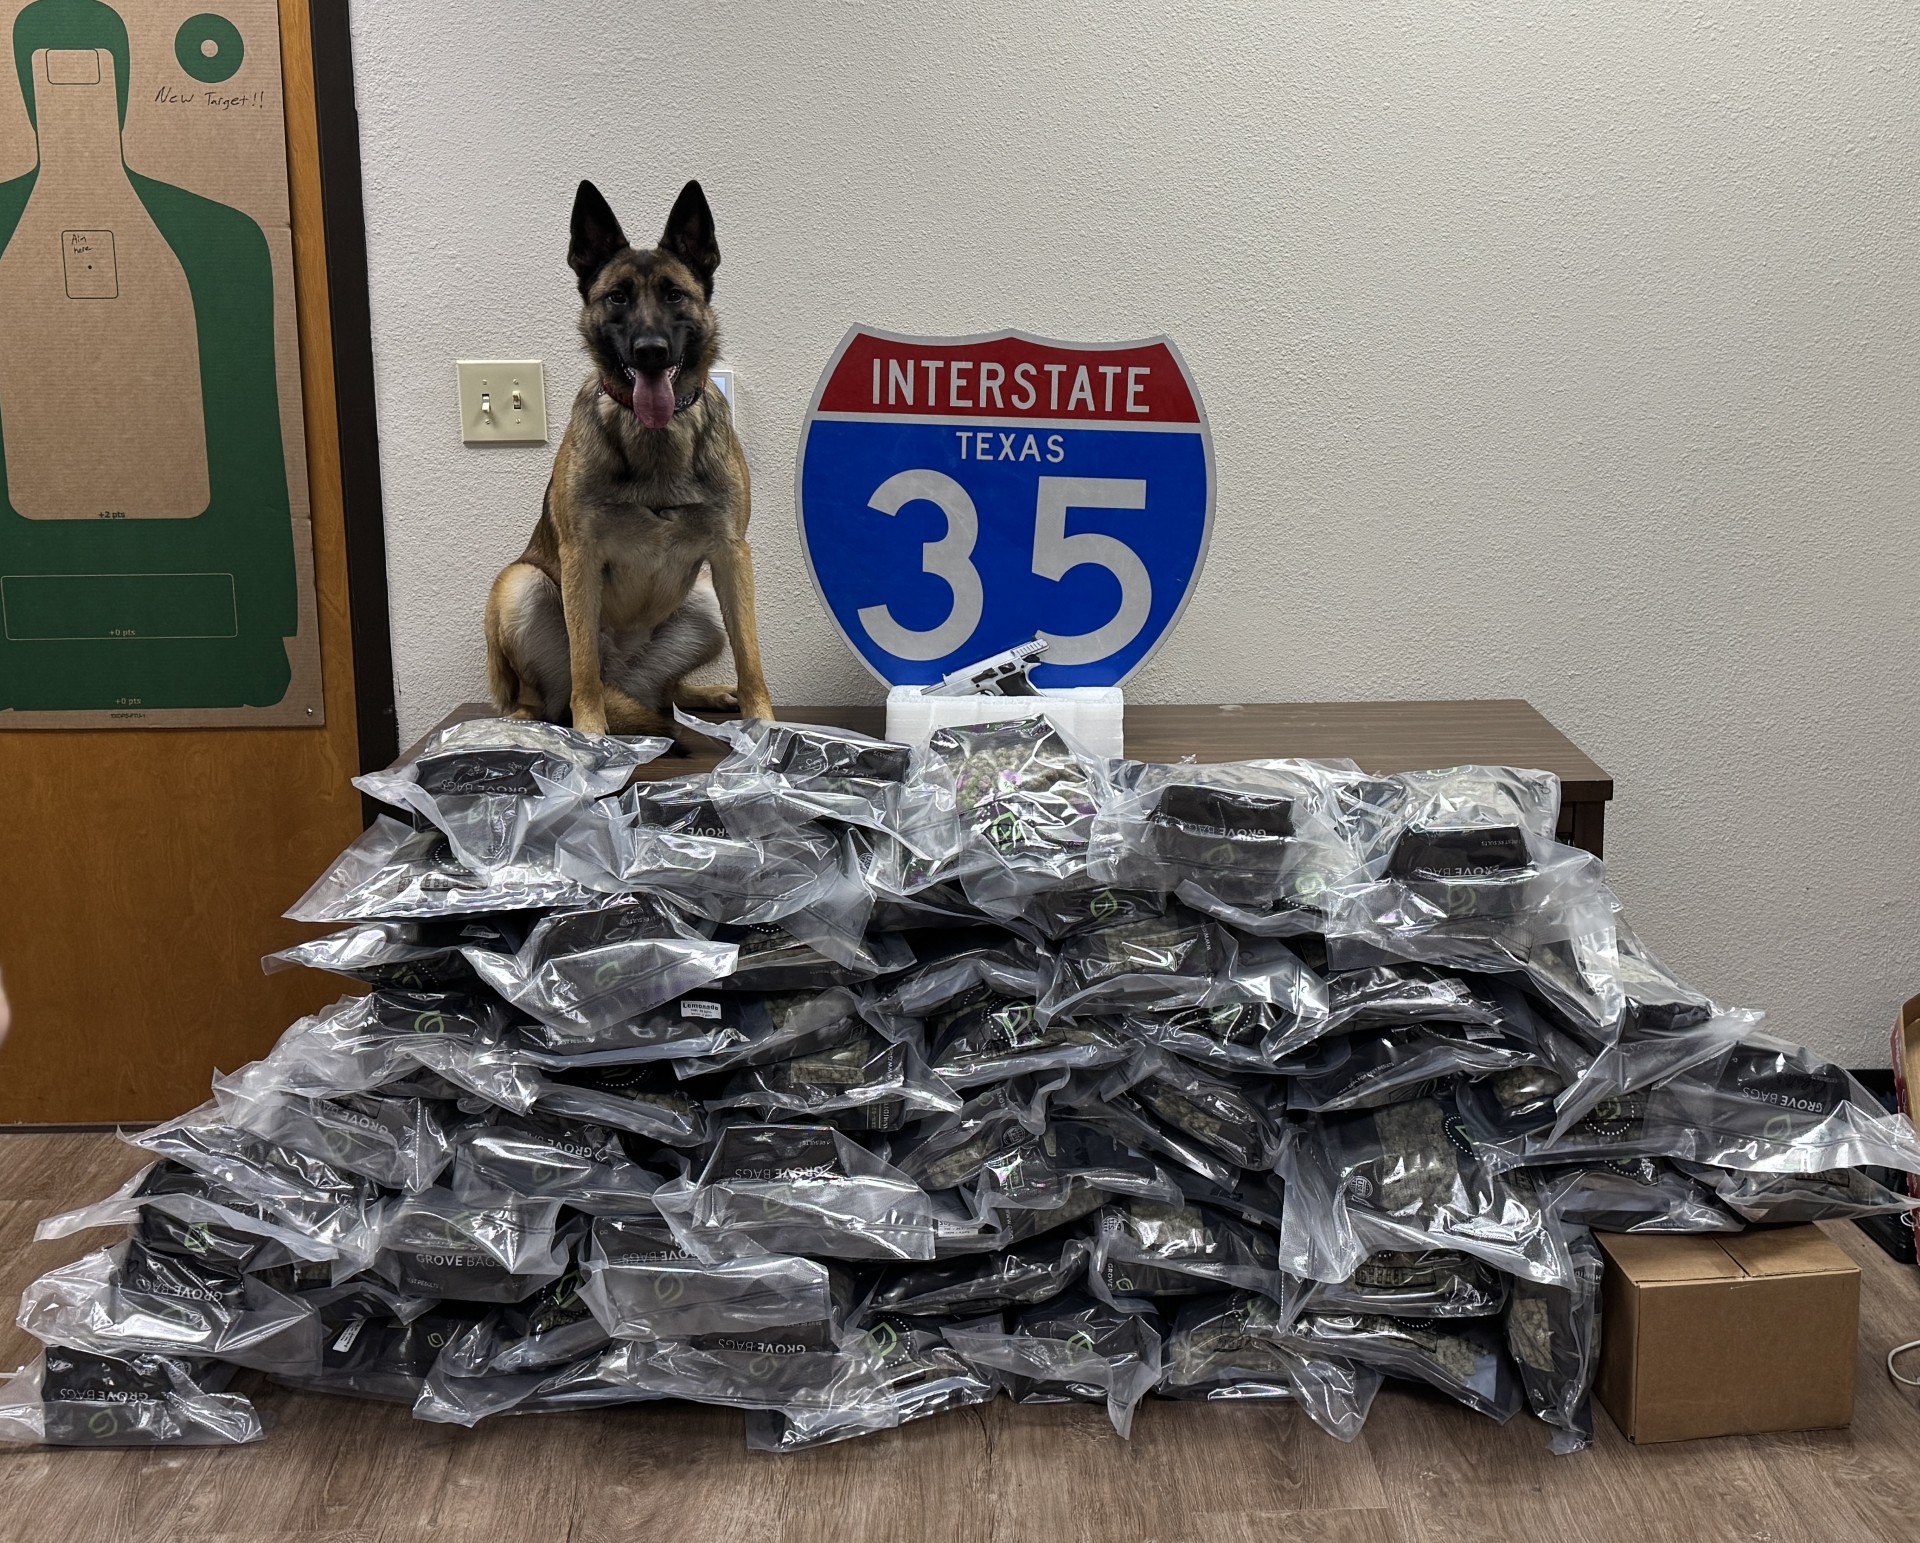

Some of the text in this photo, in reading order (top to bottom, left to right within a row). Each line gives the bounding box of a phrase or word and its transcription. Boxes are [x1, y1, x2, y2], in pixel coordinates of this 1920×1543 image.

[154, 86, 265, 111] New Target!!
[872, 358, 1151, 413] INTERSTATE
[955, 431, 1065, 463] TEXAS
[98, 511, 126, 519] +2 pts
[857, 468, 1153, 666] 35
[122, 629, 136, 637] pts
[687, 827, 731, 838] ROVE
[1742, 1086, 1823, 1113] GROVE BAGS
[340, 1111, 388, 1134] GROVE
[735, 1168, 771, 1180] BAGS
[416, 1253, 463, 1266] GROVE
[660, 1249, 690, 1261] OVE
[175, 1285, 223, 1301] GROVE
[718, 1338, 807, 1355] GROVE BAGS
[60, 1388, 149, 1401] GROVE BAGS
